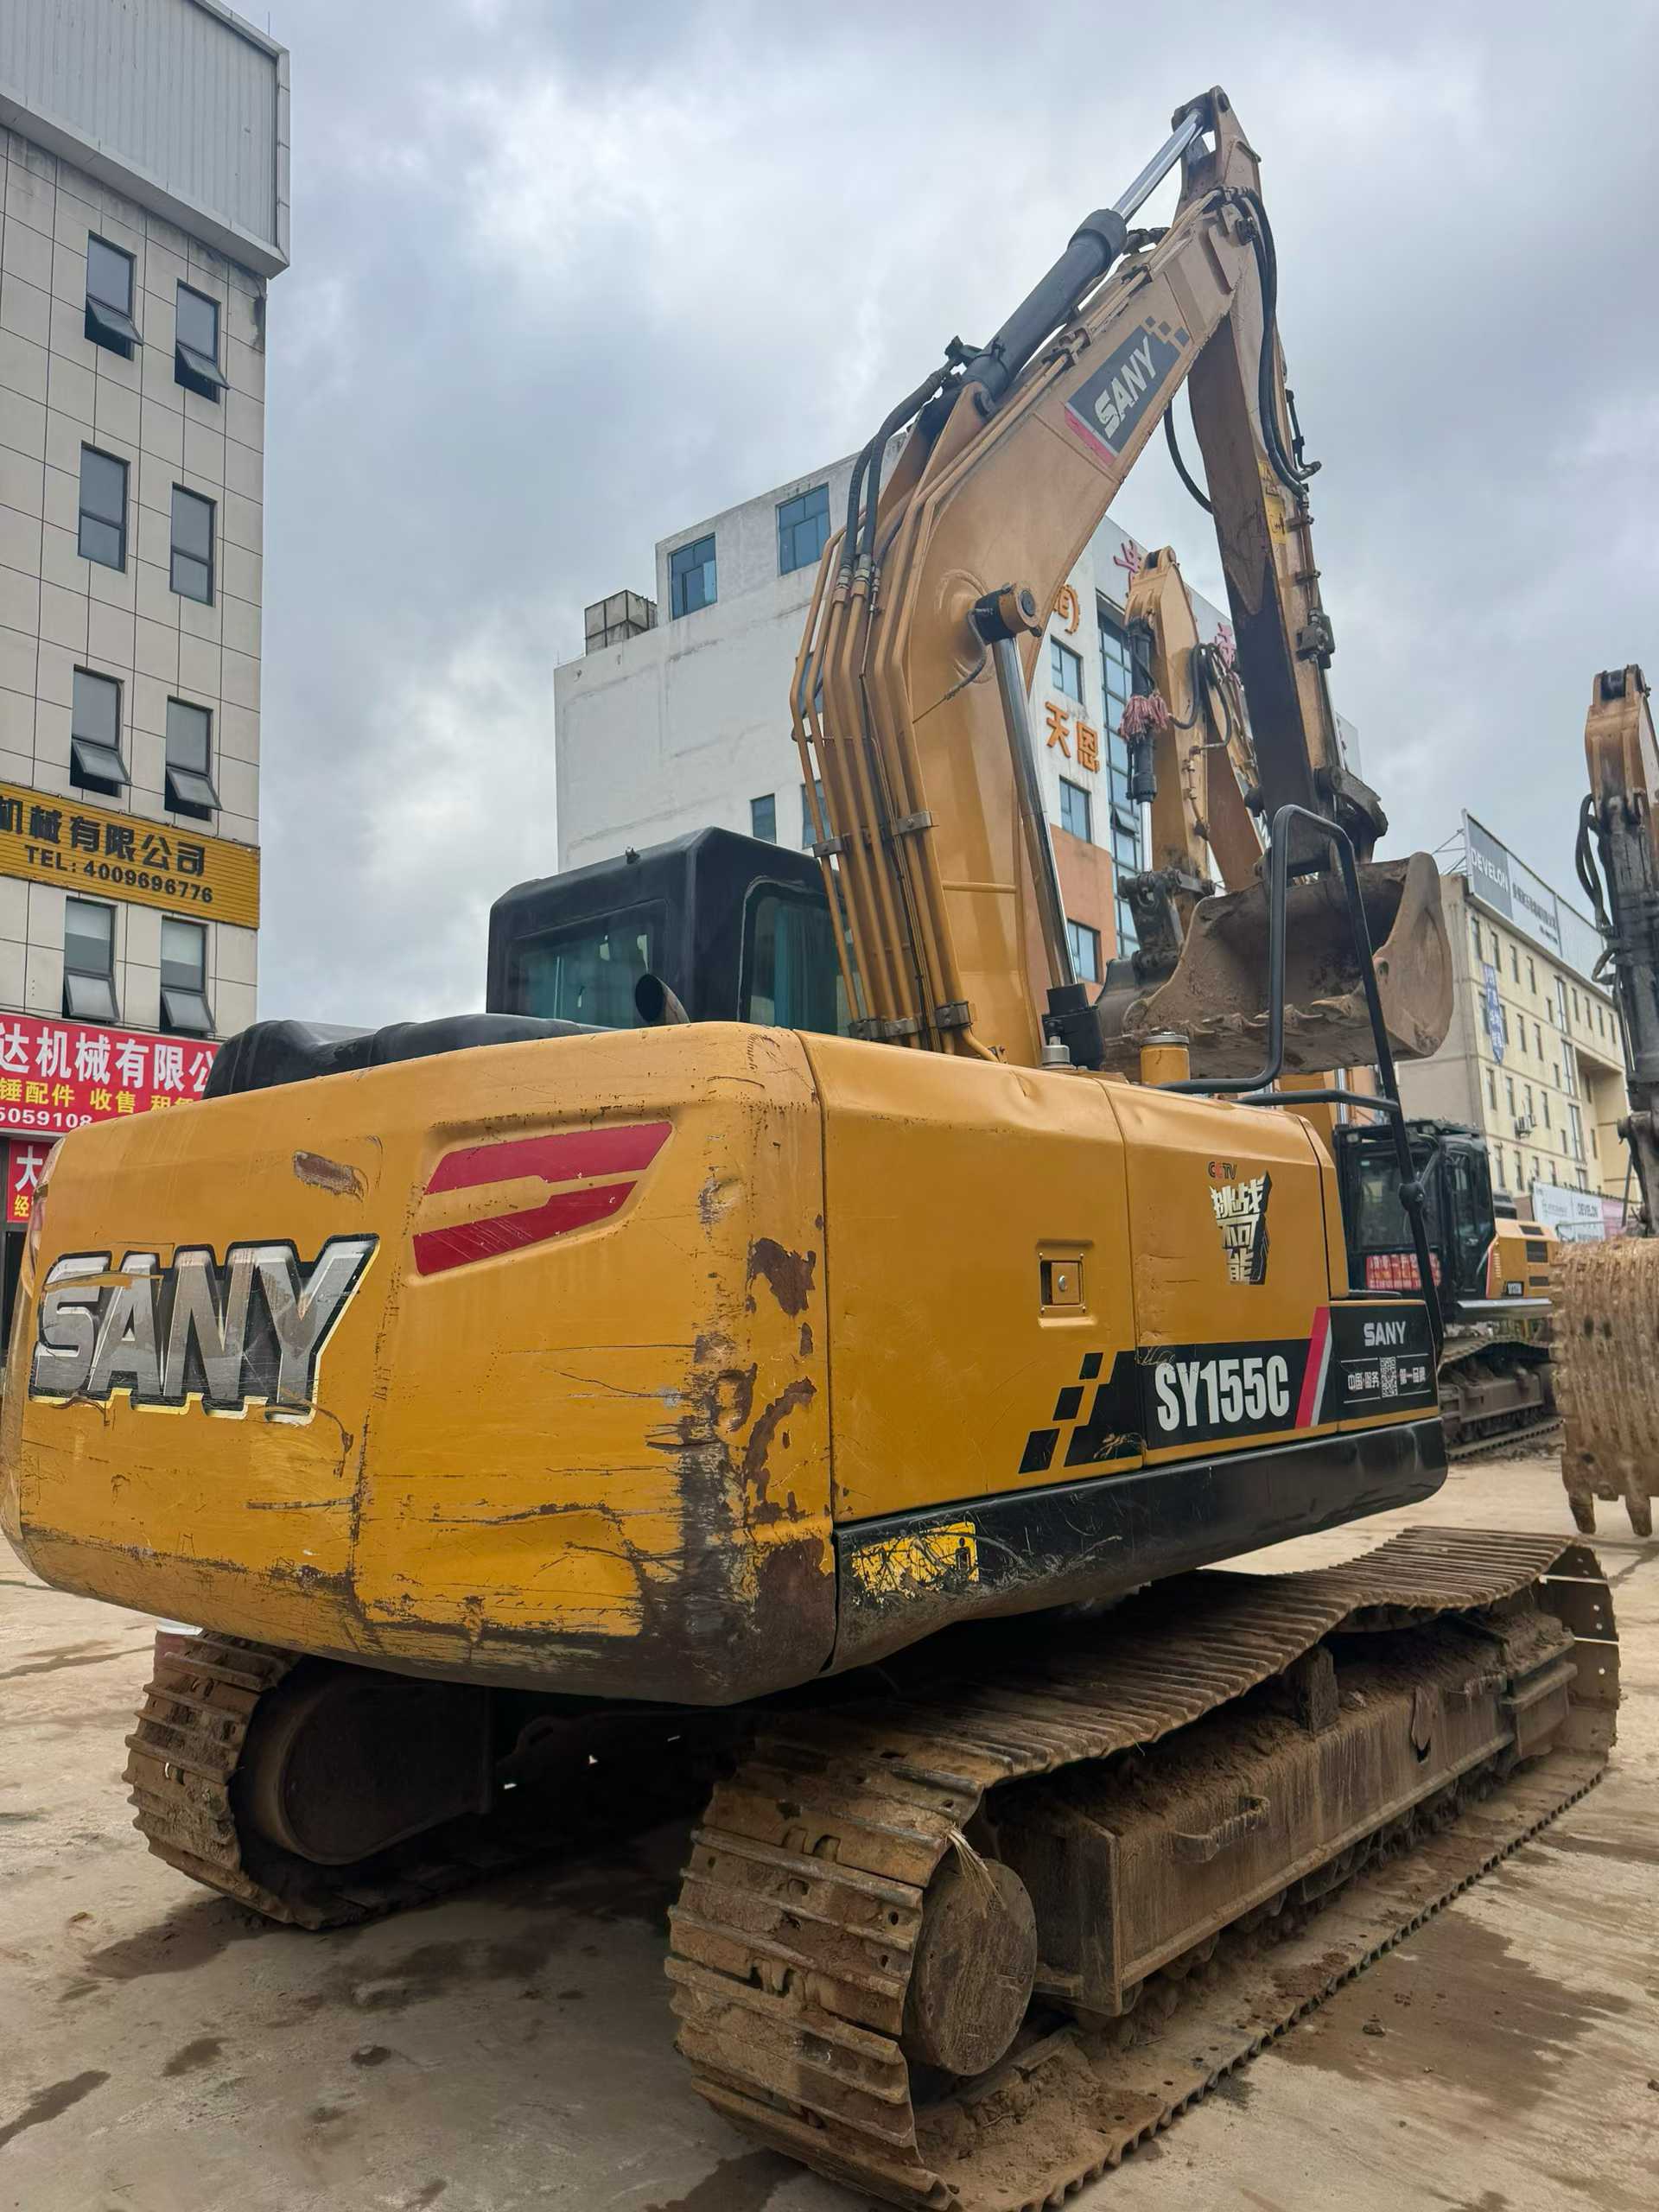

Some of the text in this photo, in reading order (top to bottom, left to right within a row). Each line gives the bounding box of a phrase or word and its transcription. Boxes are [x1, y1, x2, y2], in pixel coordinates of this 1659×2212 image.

[1094, 335, 1157, 439] SANY
[1470, 846, 1509, 893] DEVELON
[90, 1087, 137, 1115] 收售
[29, 1234, 380, 1424] SANY
[1363, 1321, 1407, 1346] SANY
[1154, 1355, 1291, 1432] SY155C
